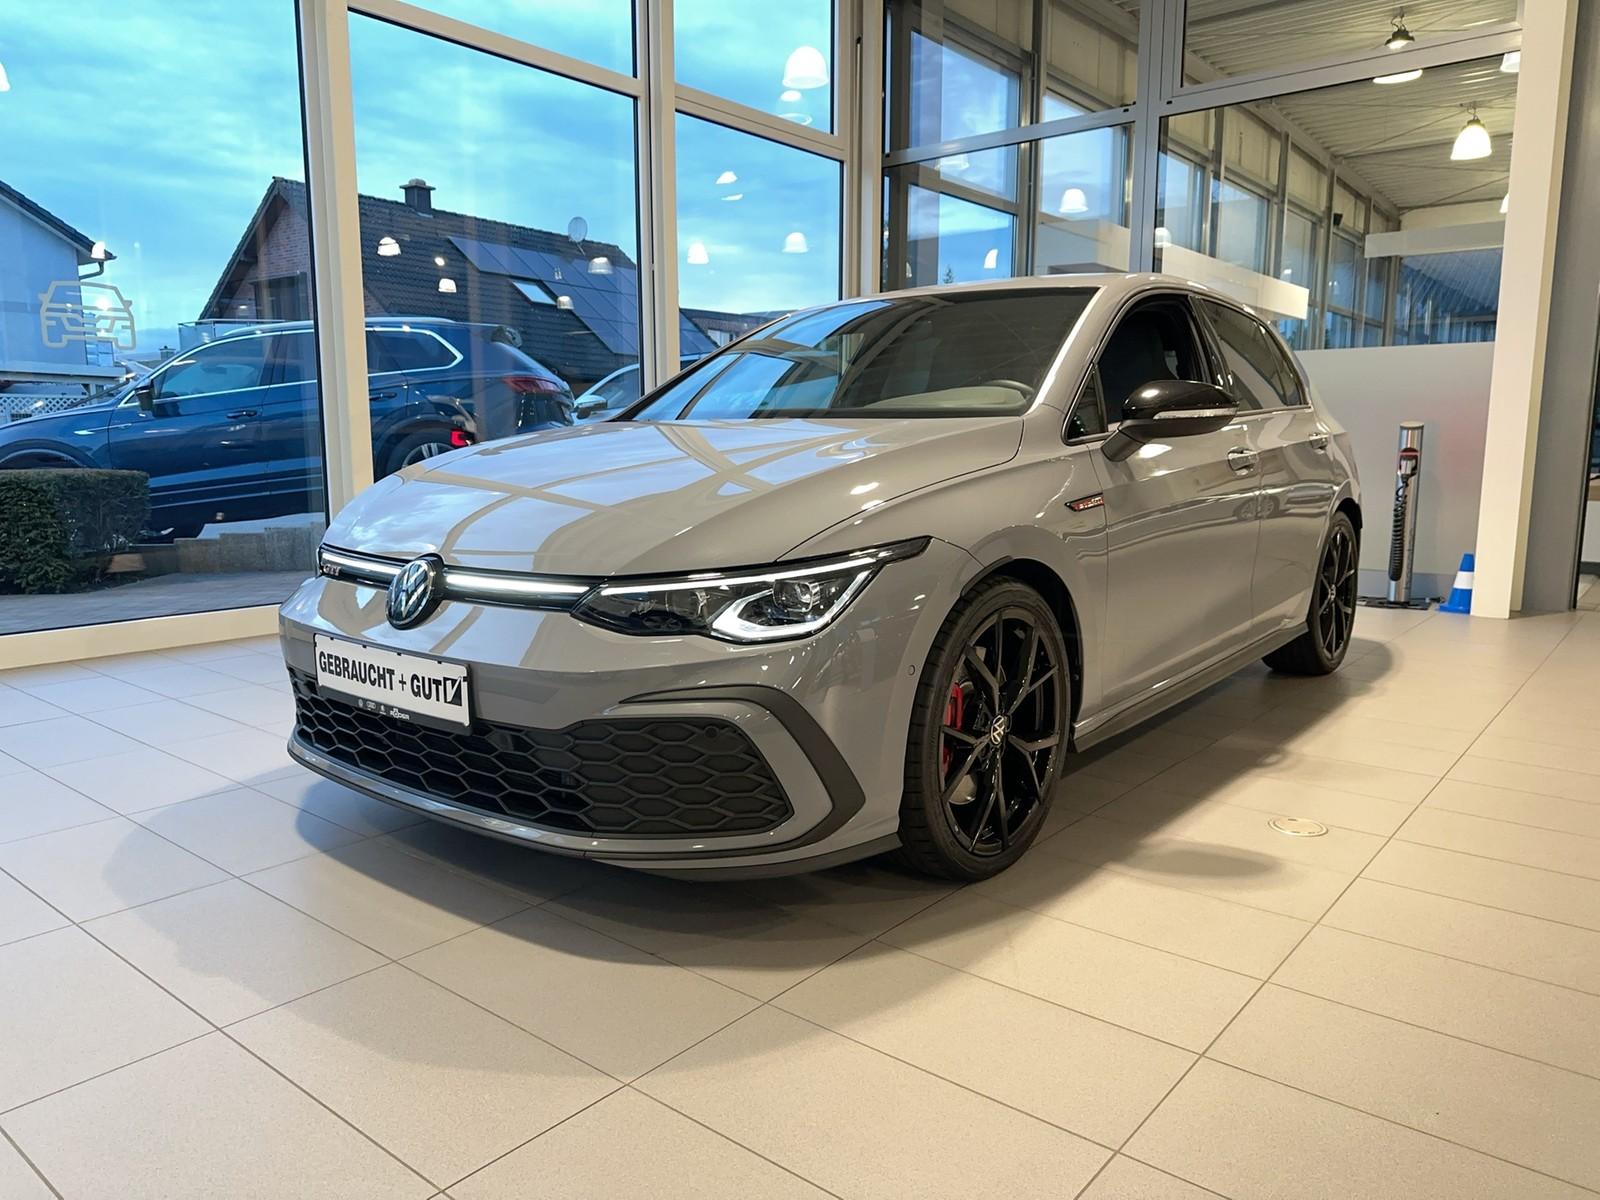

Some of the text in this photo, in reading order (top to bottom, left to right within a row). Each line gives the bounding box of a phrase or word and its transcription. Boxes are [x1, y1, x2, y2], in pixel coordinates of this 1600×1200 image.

[323, 563, 340, 576] GTI
[318, 651, 442, 702] GEBRAUCHT + GUT
